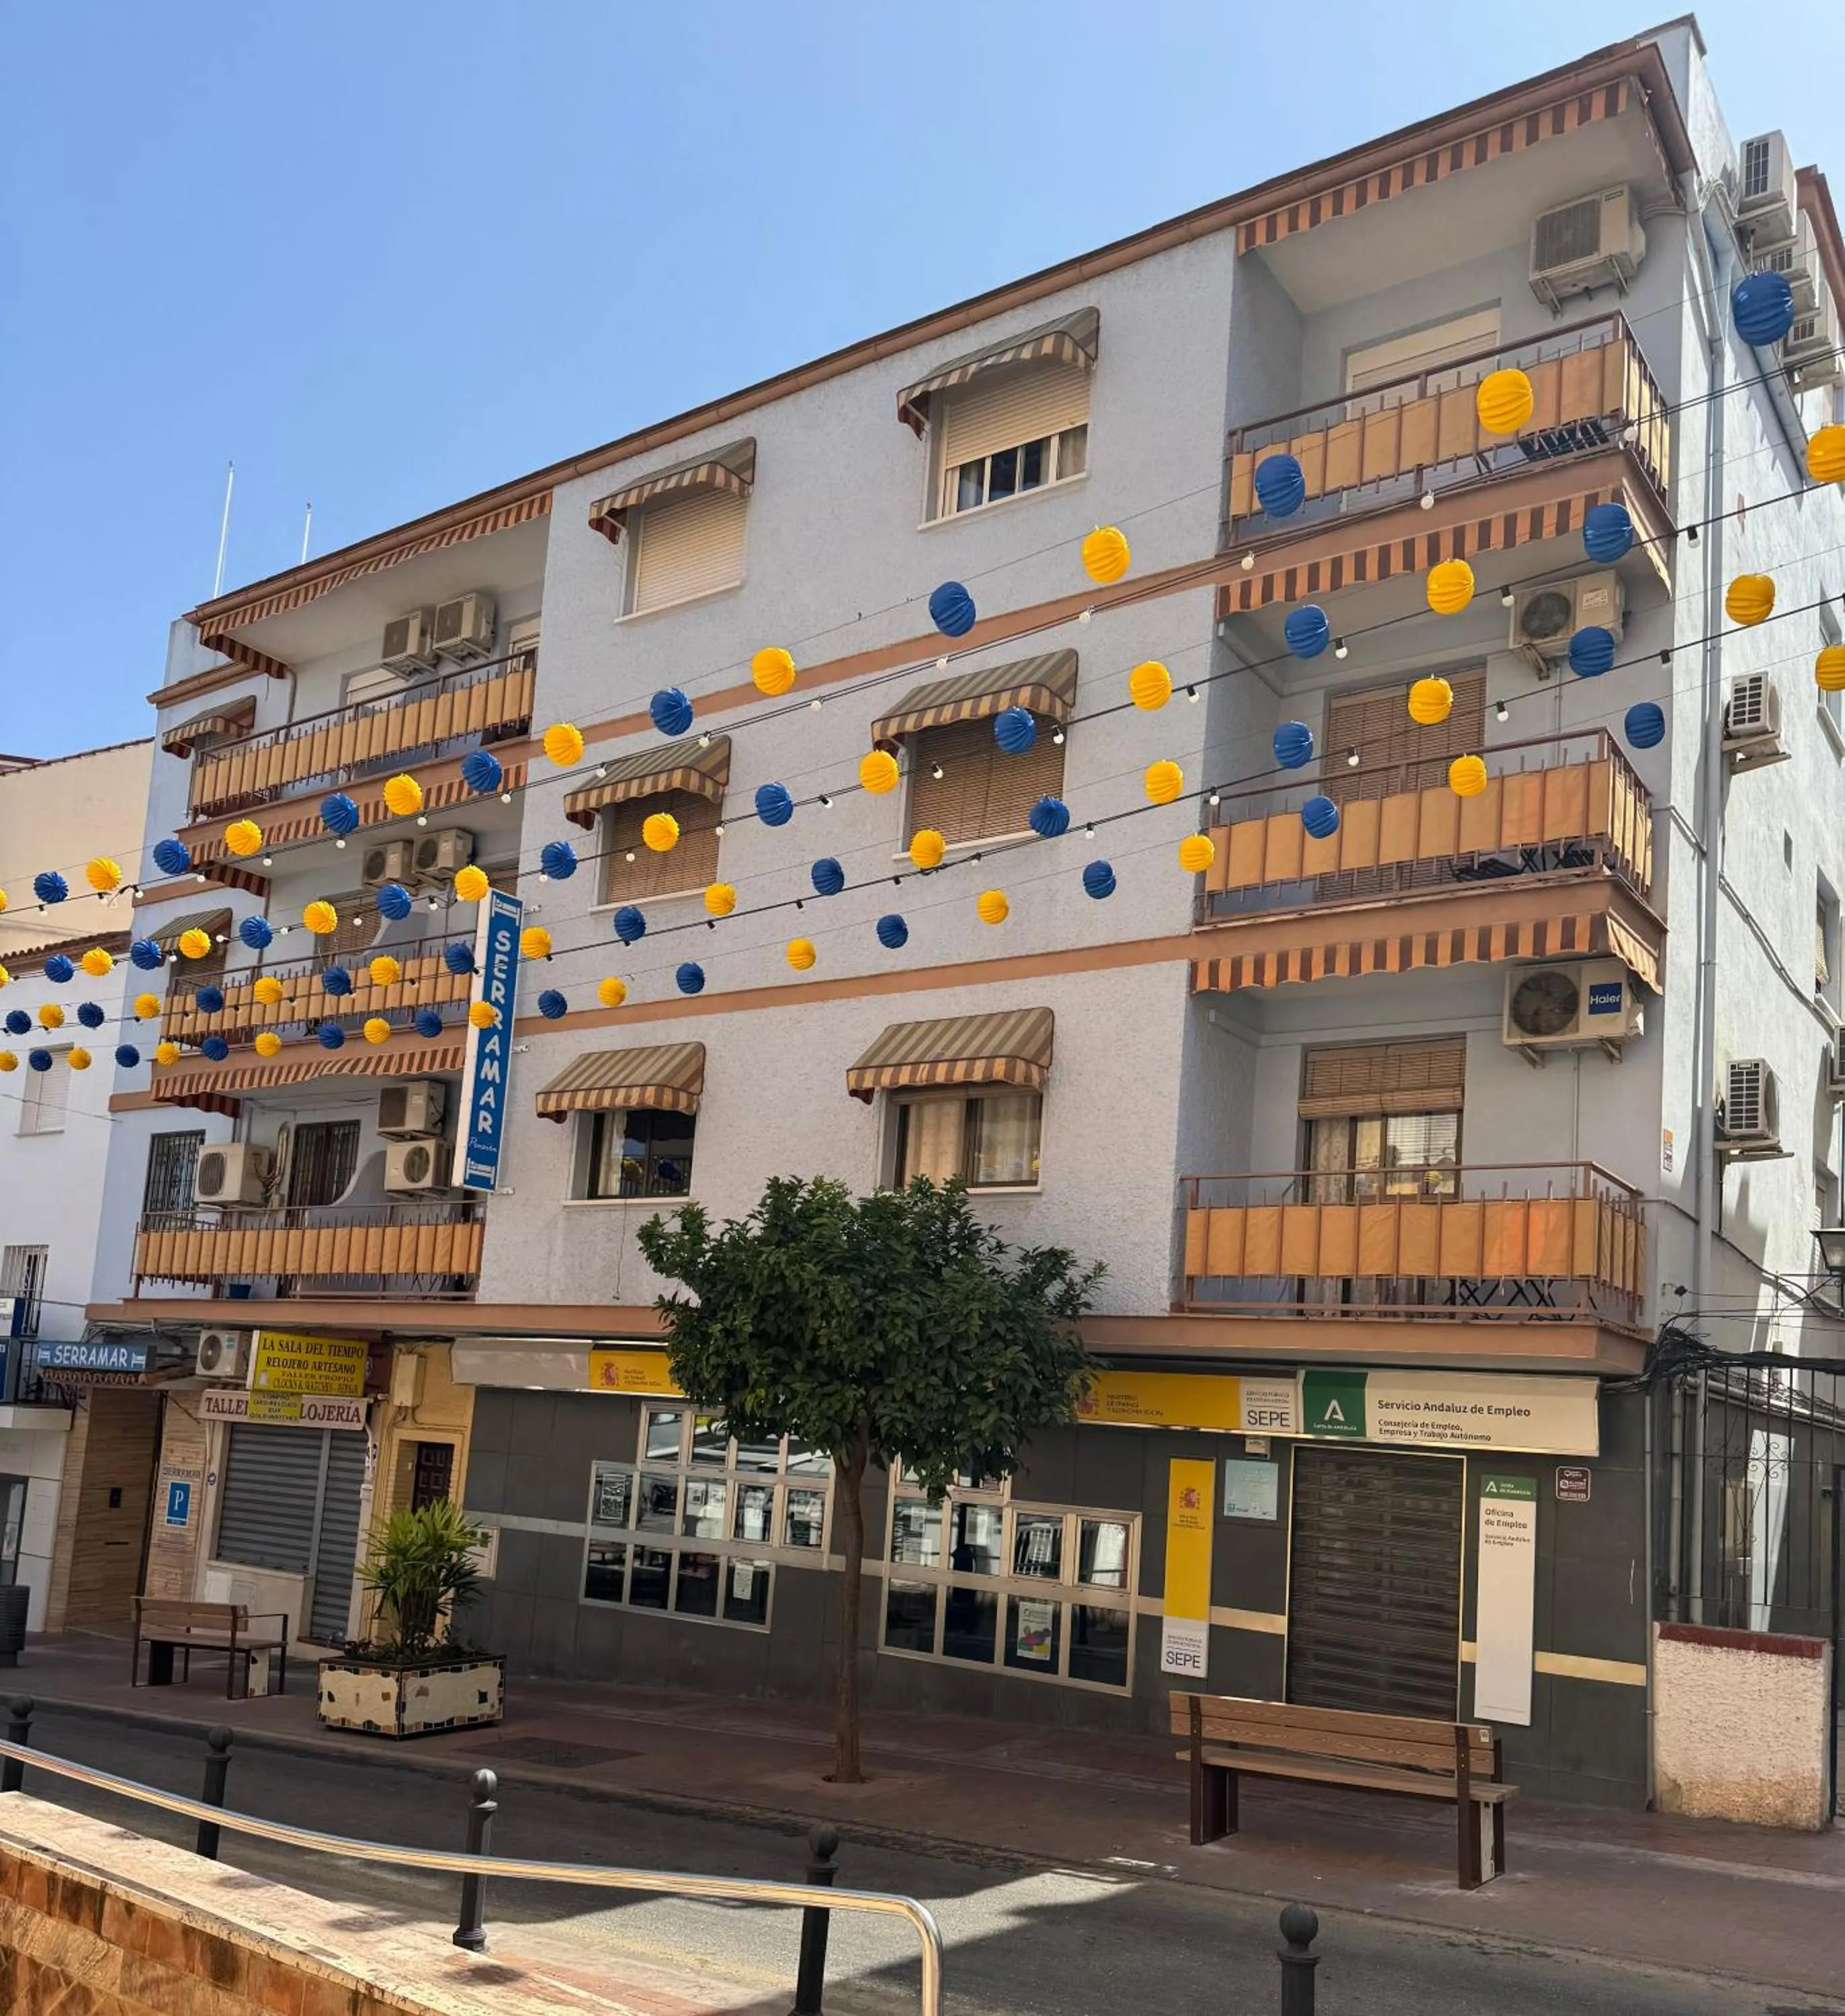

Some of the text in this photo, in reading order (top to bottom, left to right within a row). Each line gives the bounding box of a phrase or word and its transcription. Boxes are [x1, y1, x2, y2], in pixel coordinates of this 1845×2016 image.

[1590, 994, 1621, 1005] Haier
[478, 929, 511, 1134] SERRAMAR
[53, 1345, 128, 1368] SERRAMAR
[263, 1338, 364, 1359] LA SALA DEL TIEMPO
[267, 1356, 356, 1375] RELOJERO ARTESANO
[205, 1397, 361, 1423] TALLE LOJERÍA
[1378, 1400, 1531, 1417] Servicio Andaluz de Empleo
[1248, 1409, 1291, 1428] SEPE
[1420, 1421, 1430, 1429] de
[1431, 1422, 1463, 1432] Empleo,
[1379, 1429, 1412, 1437] Empresa
[1420, 1430, 1448, 1440] Trabajo
[1450, 1432, 1492, 1441] Autónomo
[175, 1490, 183, 1511] P
[1484, 1508, 1514, 1517] Oficina
[1496, 1519, 1527, 1529] Empleo
[1166, 1650, 1201, 1669] SEPE
